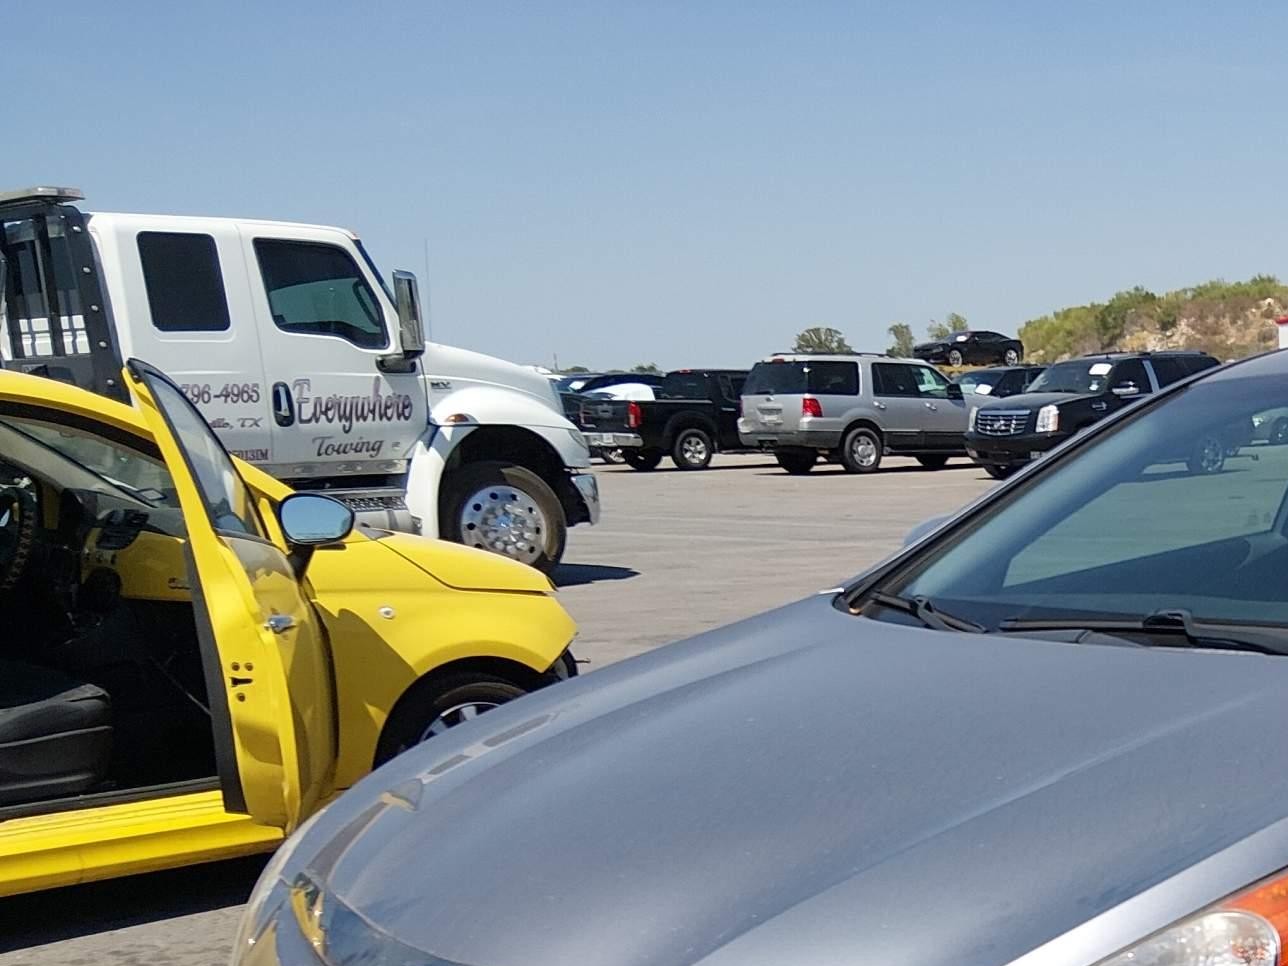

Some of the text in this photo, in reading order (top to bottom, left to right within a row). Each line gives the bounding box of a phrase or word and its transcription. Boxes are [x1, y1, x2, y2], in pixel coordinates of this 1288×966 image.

[293, 375, 413, 433] Everywhere
[236, 416, 264, 428] TX
[312, 434, 385, 458] Towing
